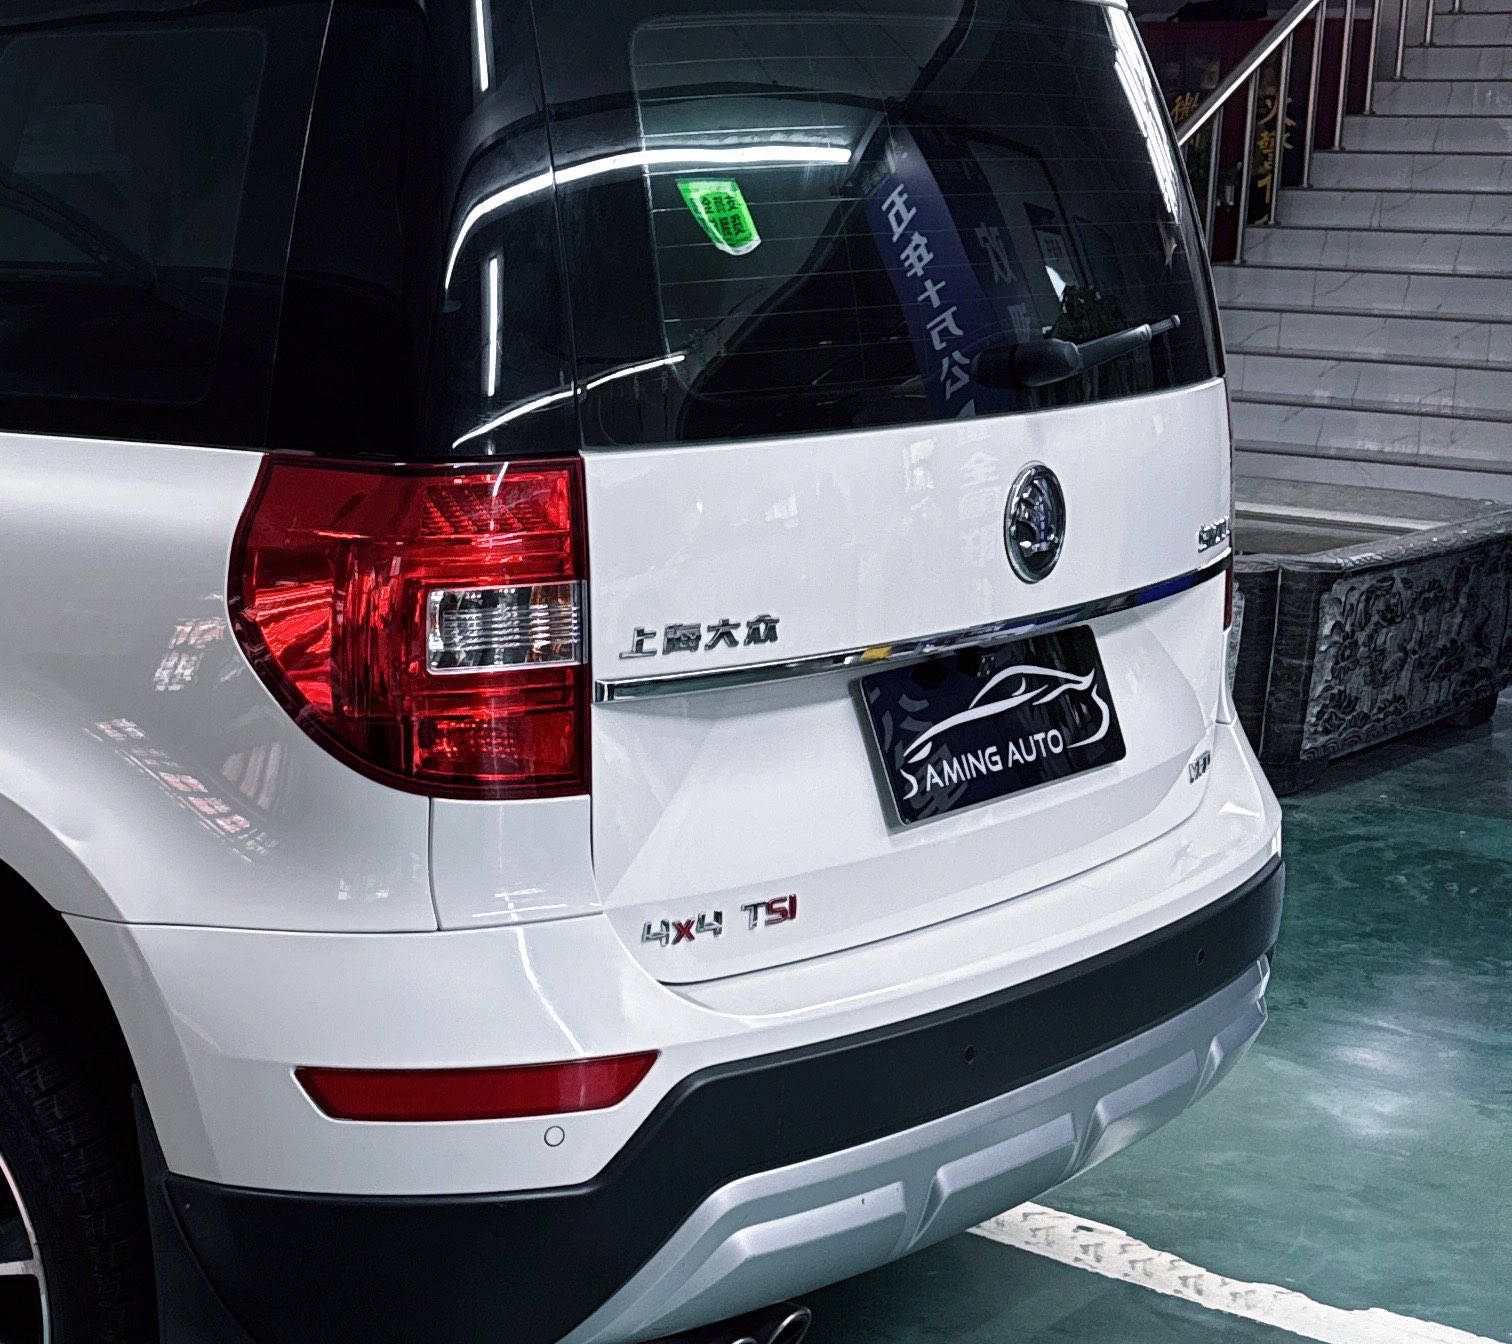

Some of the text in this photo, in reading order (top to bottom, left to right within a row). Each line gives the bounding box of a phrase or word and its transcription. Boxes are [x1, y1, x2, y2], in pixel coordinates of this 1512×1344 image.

[618, 614, 780, 660] 上海大众
[925, 729, 1064, 792] AMING AUTO
[642, 893, 797, 946] 4x4 TSI
